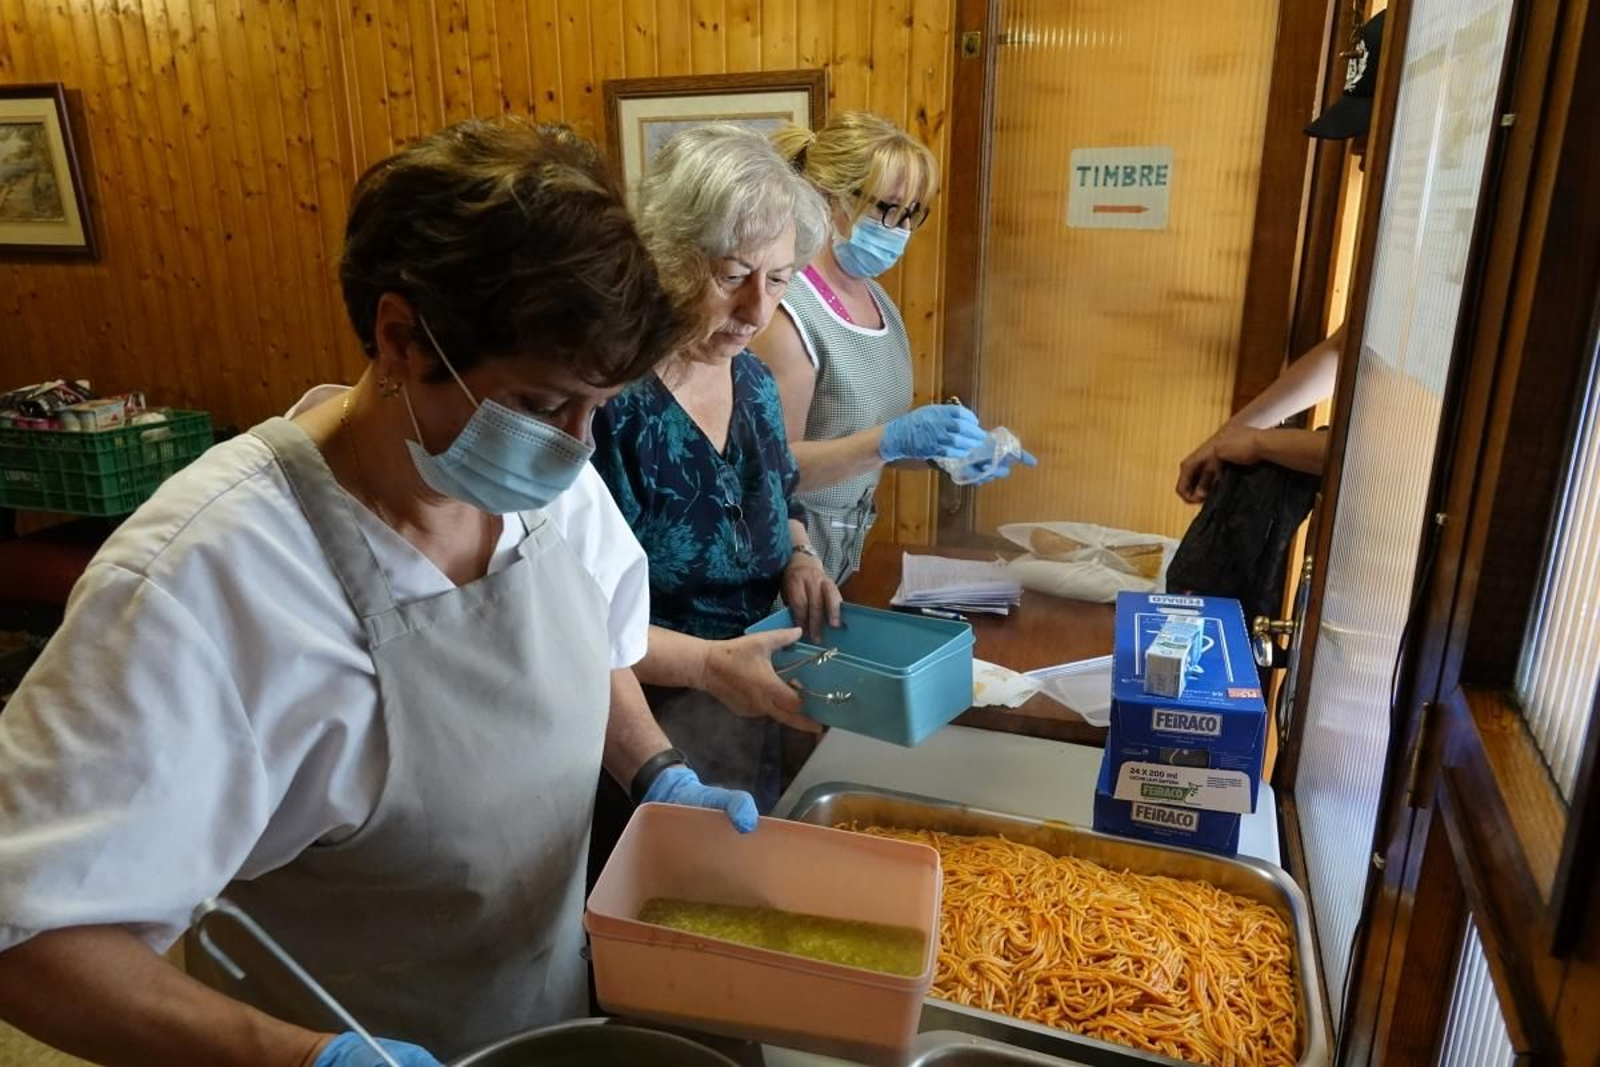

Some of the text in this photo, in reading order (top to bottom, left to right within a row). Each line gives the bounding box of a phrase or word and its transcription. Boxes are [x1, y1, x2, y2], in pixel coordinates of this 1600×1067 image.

[1076, 164, 1168, 188] TIMBRE
[1130, 767, 1140, 775] 24
[1149, 769, 1165, 778] 200
[1166, 772, 1178, 780] ml
[1142, 784, 1183, 799] FEIRACO
